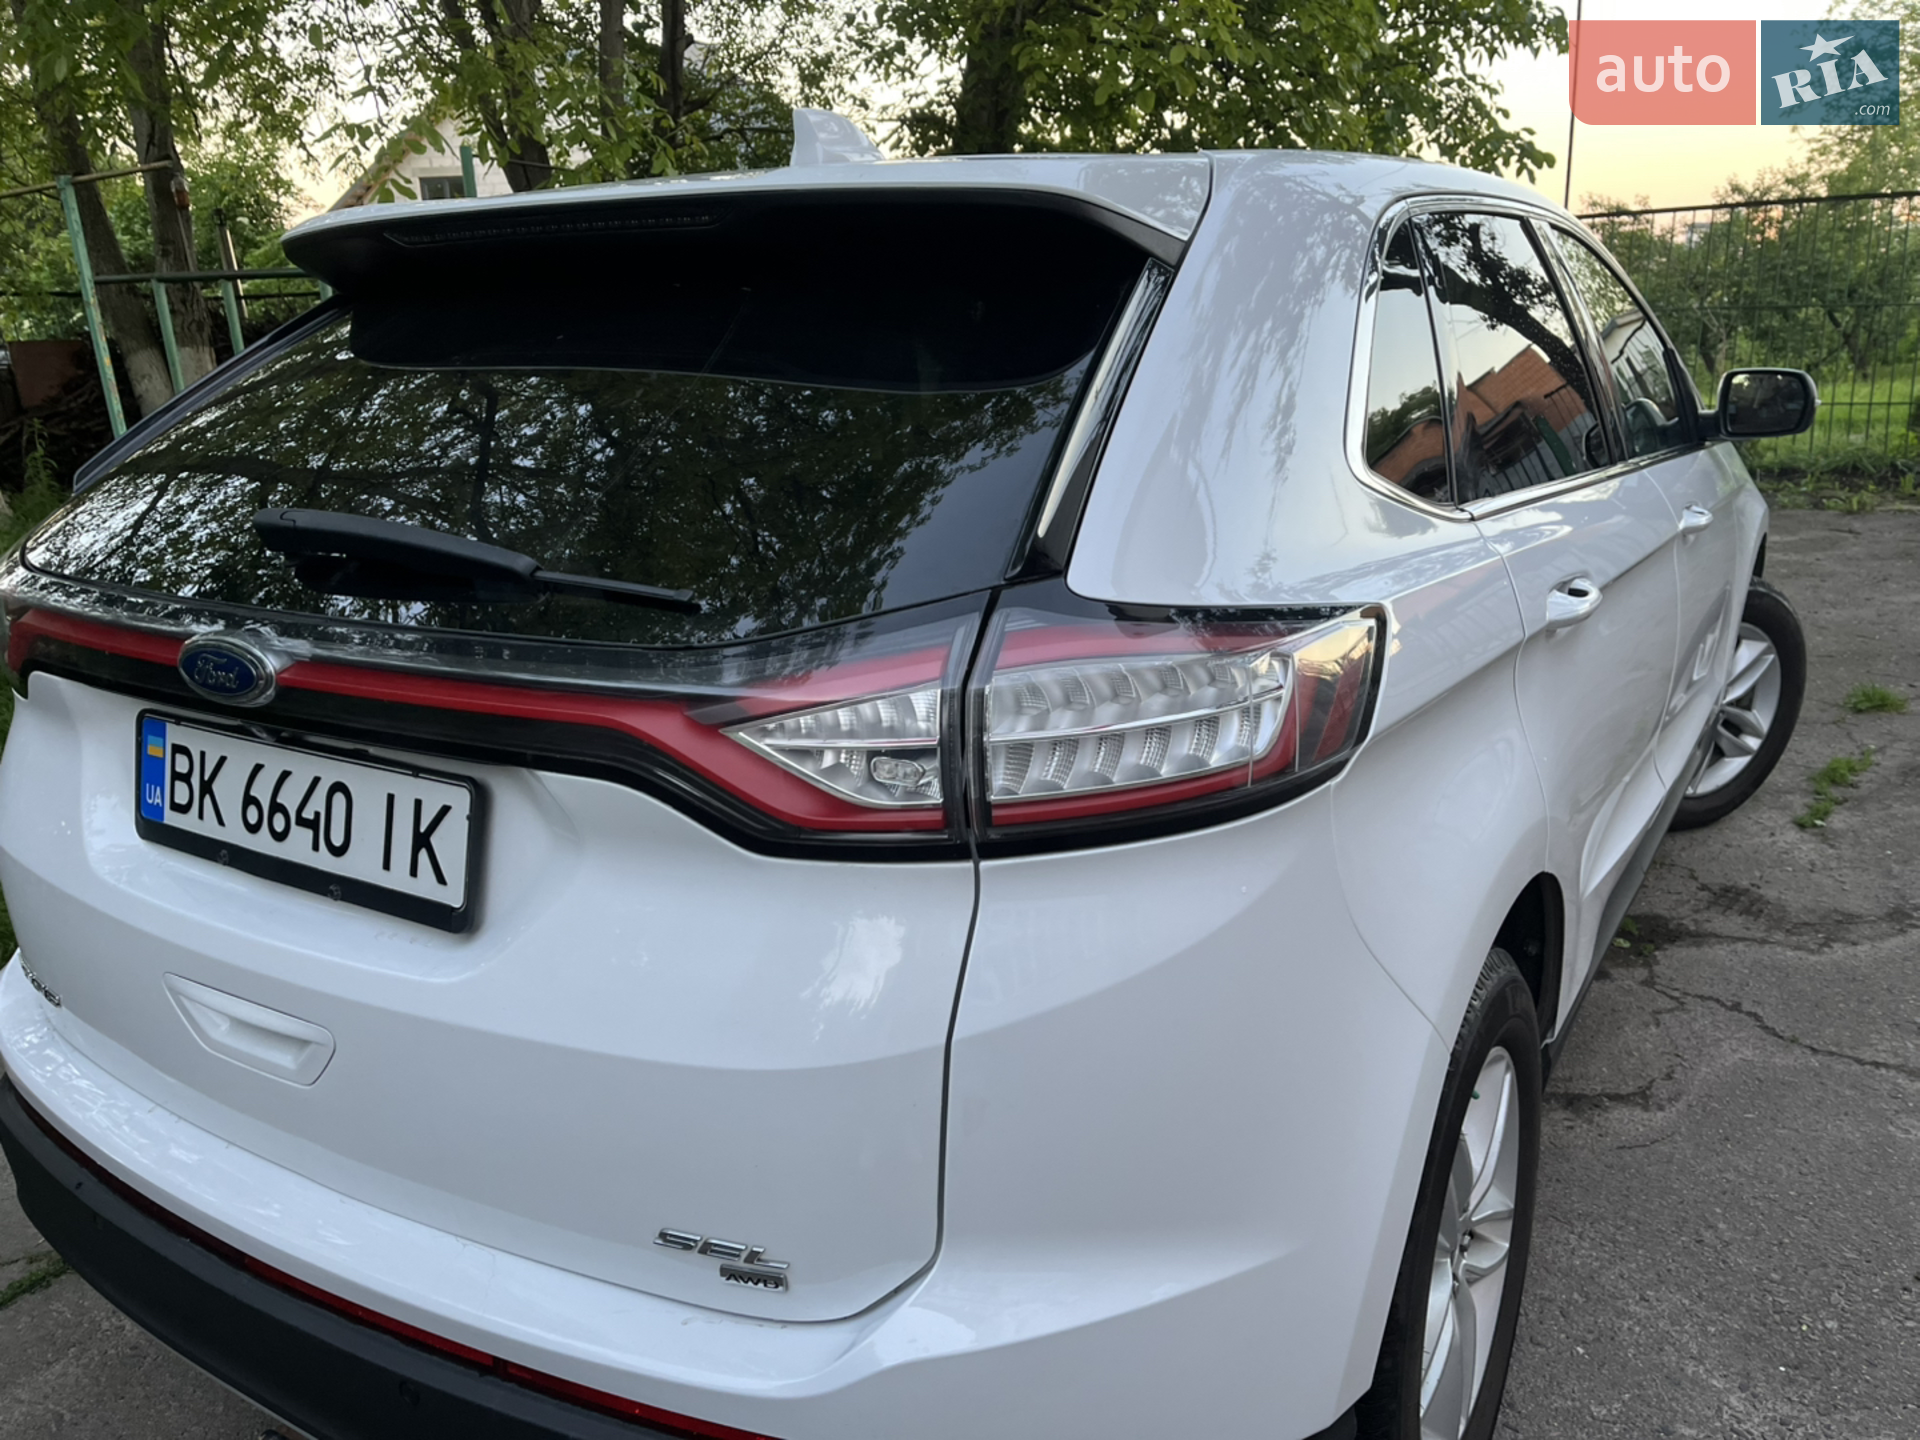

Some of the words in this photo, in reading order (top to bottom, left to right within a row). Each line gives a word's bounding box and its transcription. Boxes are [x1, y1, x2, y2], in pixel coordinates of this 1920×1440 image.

[194, 653, 239, 689] Ford
[145, 783, 163, 808] UA
[168, 742, 228, 828] BK
[241, 762, 353, 858] 6640
[382, 792, 452, 886] IK
[653, 1227, 790, 1269] SEL
[724, 1272, 780, 1290] AWD
